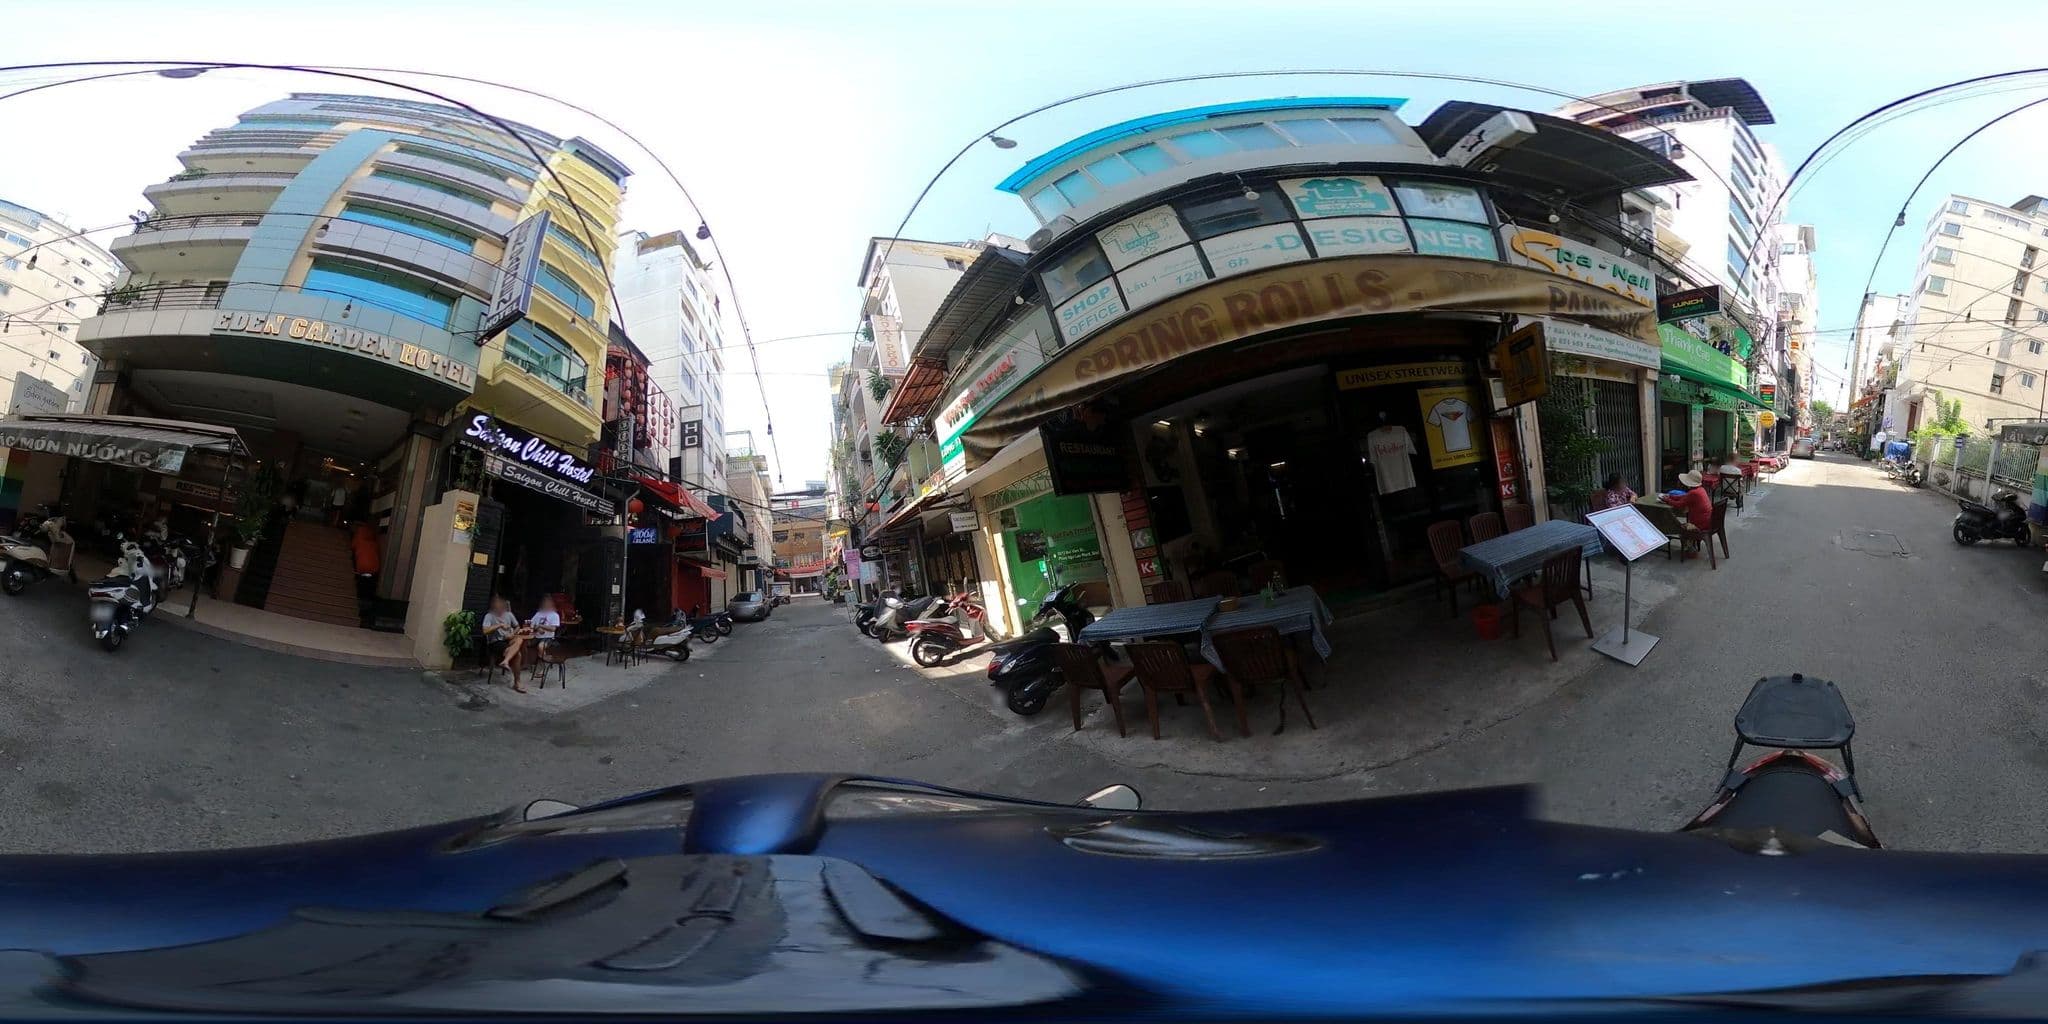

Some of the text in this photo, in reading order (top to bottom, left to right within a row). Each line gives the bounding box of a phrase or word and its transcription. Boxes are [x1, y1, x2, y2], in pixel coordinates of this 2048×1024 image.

[1274, 226, 1484, 252] DESIGNER
[485, 303, 520, 331] HOTEL
[1062, 286, 1111, 321] SHOP
[1672, 297, 1704, 309] LUNCH
[1068, 303, 1119, 337] OFFICE
[213, 312, 474, 389] EDEN GARDEN HOTEL
[1075, 302, 1218, 383] SPRING
[1345, 369, 1391, 385] UNISEX
[521, 437, 557, 469] Chill
[556, 453, 594, 484] Hostel
[504, 465, 544, 487] Saigon
[544, 482, 569, 497] Chill
[1141, 561, 1159, 575] K+
